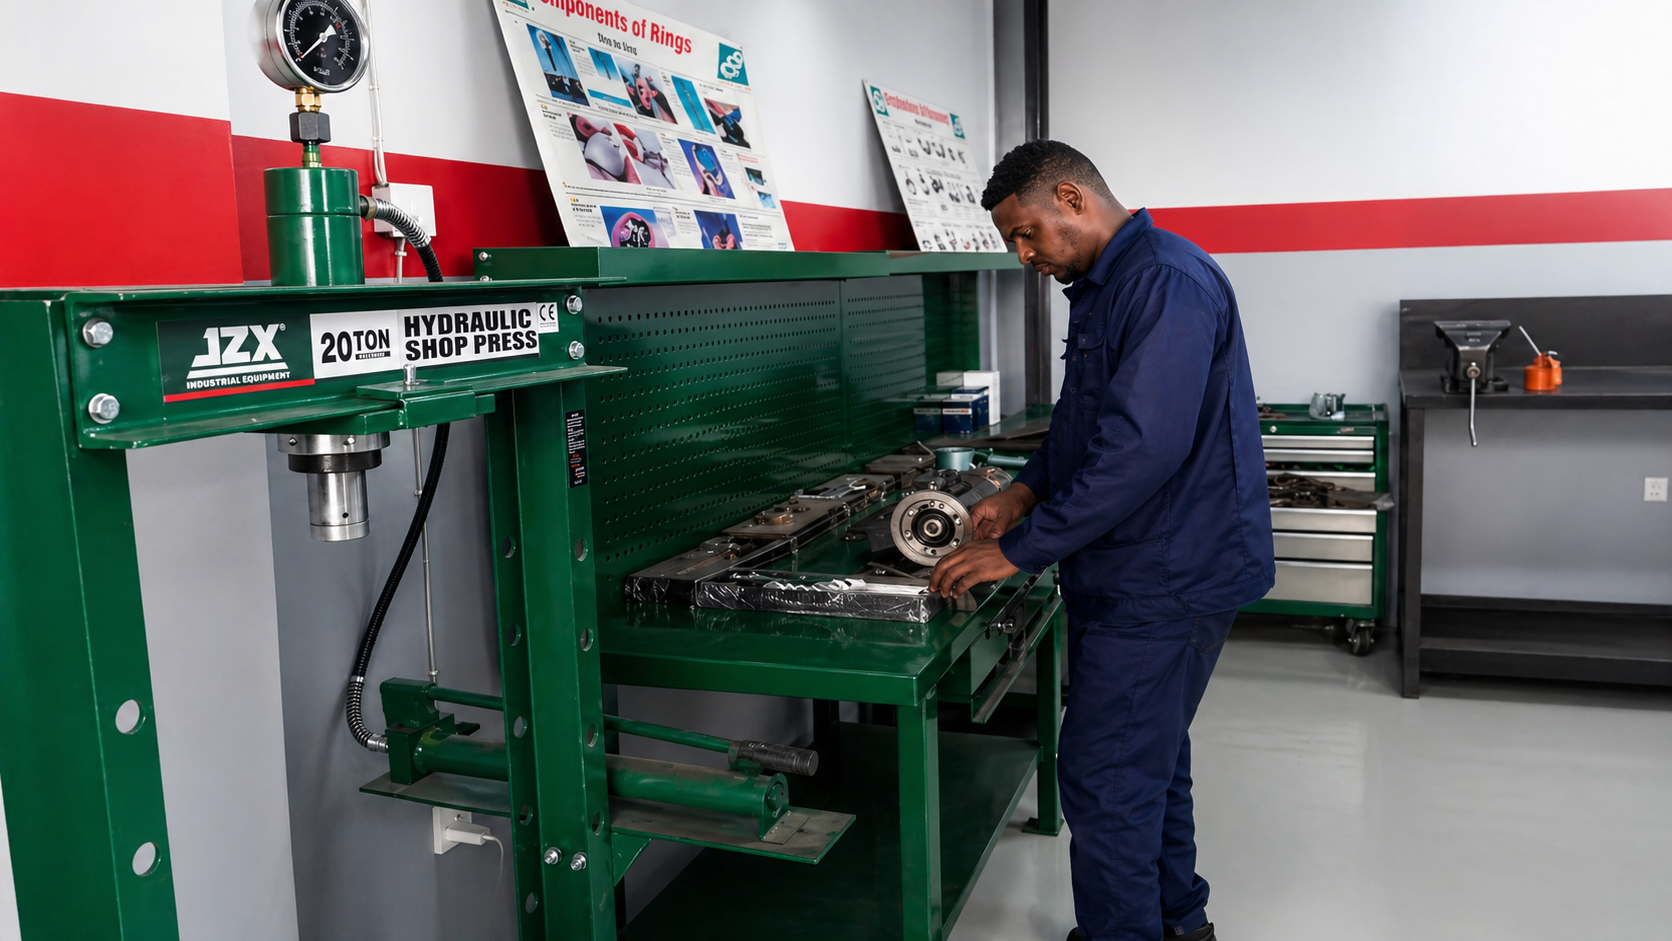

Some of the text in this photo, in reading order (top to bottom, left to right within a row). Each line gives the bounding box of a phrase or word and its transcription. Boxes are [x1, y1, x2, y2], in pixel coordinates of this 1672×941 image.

[541, 0, 628, 32] ponents
[632, 18, 647, 39] of
[650, 21, 692, 55] Rings
[404, 308, 532, 338] HYDRAULIC
[539, 304, 555, 321] CE
[321, 328, 390, 364] 20 TON
[405, 330, 538, 361] SHOP PRESS
[186, 371, 291, 389] INDUSTRIAL EQUIPMENT
